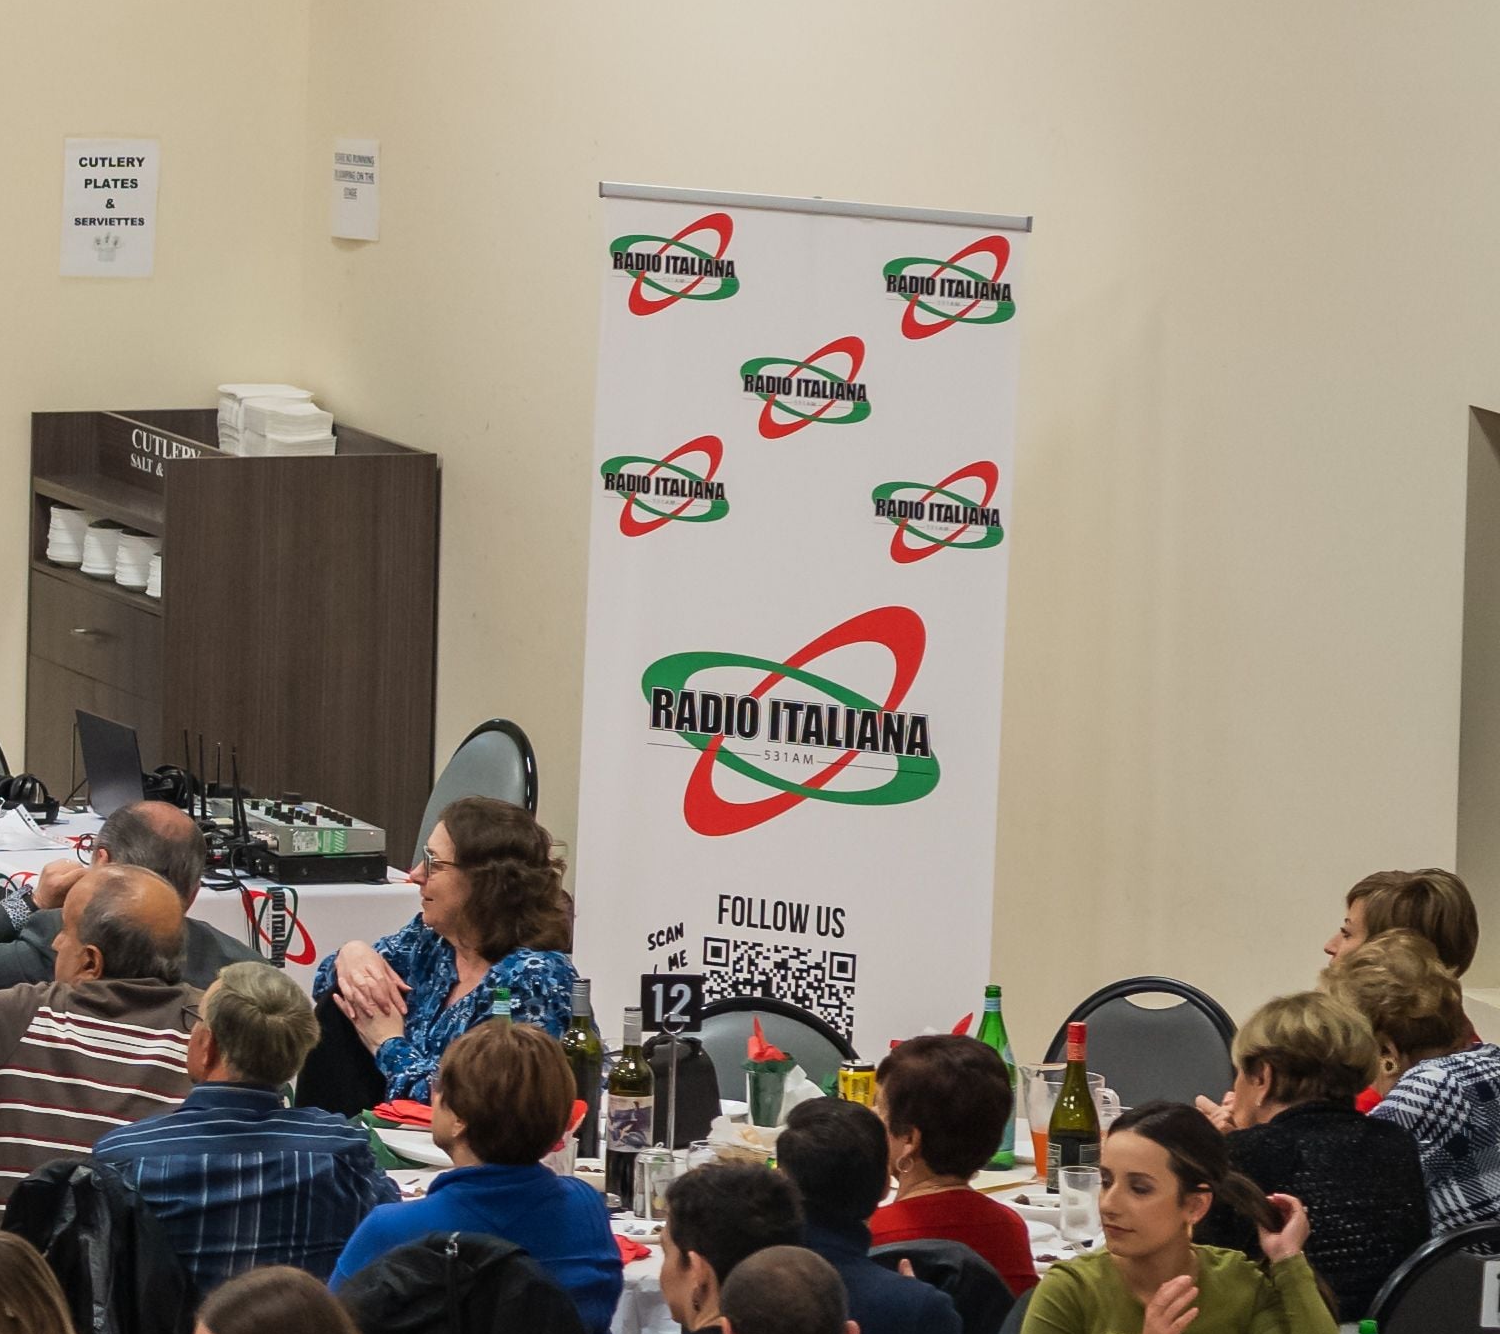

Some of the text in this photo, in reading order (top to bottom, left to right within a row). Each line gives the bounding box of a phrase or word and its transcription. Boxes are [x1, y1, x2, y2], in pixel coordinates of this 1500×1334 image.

[78, 156, 145, 167] CUTLERY
[84, 178, 139, 189] PLATES
[105, 198, 115, 209] &
[74, 217, 145, 226] SERVIETTES
[612, 251, 736, 278] RADIO ITALIANA
[886, 274, 1012, 302] RADIO ITALIANA
[743, 374, 867, 402] RADIO ITALIANA
[130, 453, 164, 477] SALT &
[604, 472, 726, 500] RADIO ITALIANA
[875, 498, 1000, 527] RADIO ITALIANA
[650, 687, 932, 758] RADIO ITALIANA
[764, 750, 814, 765] 531AM
[717, 893, 846, 938] FOLLOW US
[646, 922, 684, 951] SCAN
[668, 949, 688, 972] ME
[651, 983, 692, 1023] 12
